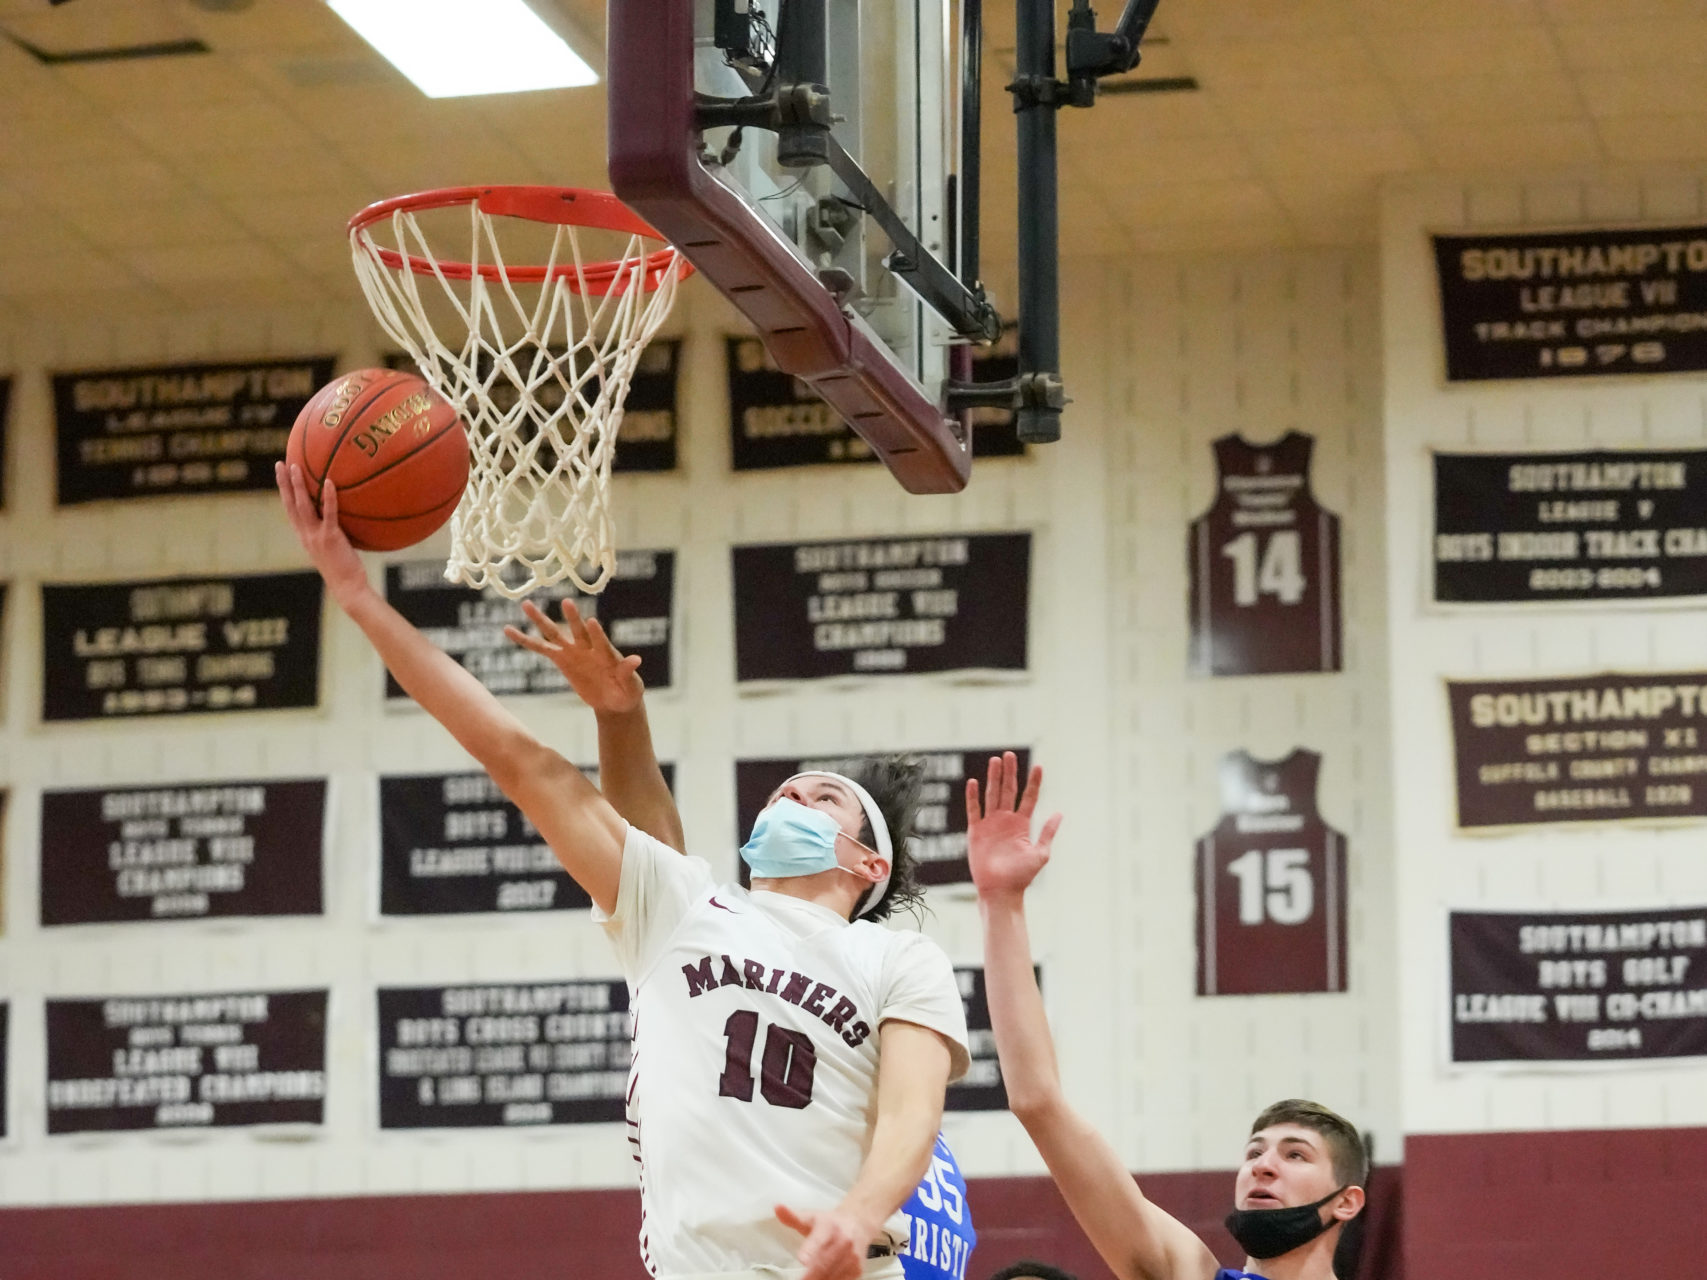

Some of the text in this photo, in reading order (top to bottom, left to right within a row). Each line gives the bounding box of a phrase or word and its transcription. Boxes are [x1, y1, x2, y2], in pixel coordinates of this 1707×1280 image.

[1520, 283, 1630, 312] LEAGUE
[1475, 321, 1565, 341] TRACK
[1509, 462, 1686, 492] SOUTHAMPTON
[1538, 501, 1619, 523] LEAGUE
[795, 539, 969, 575] SOUTHAMPTON
[1584, 529, 1660, 559] TRACK
[1222, 529, 1307, 607] 14
[807, 591, 900, 623] LEAGUE
[74, 616, 289, 657] LEAGUE VIII
[813, 618, 945, 651] CHAMPIONS
[1526, 728, 1697, 755] SECTION XI
[1569, 757, 1639, 780] COUNTY
[102, 786, 267, 821] SOUTHAMPTON
[1533, 788, 1631, 811] BASEBALL
[444, 808, 508, 841] BOYS
[108, 840, 197, 870] LEAGUE
[409, 847, 492, 878] LEAGUE
[116, 863, 245, 897] CHAMPIONS
[497, 880, 558, 910] 2017
[1227, 849, 1314, 925] 15
[1519, 919, 1706, 954] SOUTHAMPTON
[1539, 955, 1690, 988] BOYS GOLF
[103, 995, 269, 1029] SOUTHAMPTON
[441, 983, 611, 1018] SOUTHAMPTON
[682, 955, 870, 1048] MARINERS
[1455, 994, 1548, 1023] LEAGUE
[396, 1017, 460, 1047] BOYS
[464, 1015, 541, 1045] CROSS
[113, 1046, 203, 1076] LEAGUE
[719, 1009, 817, 1109] 10
[200, 1070, 326, 1102] CHAMPIONS
